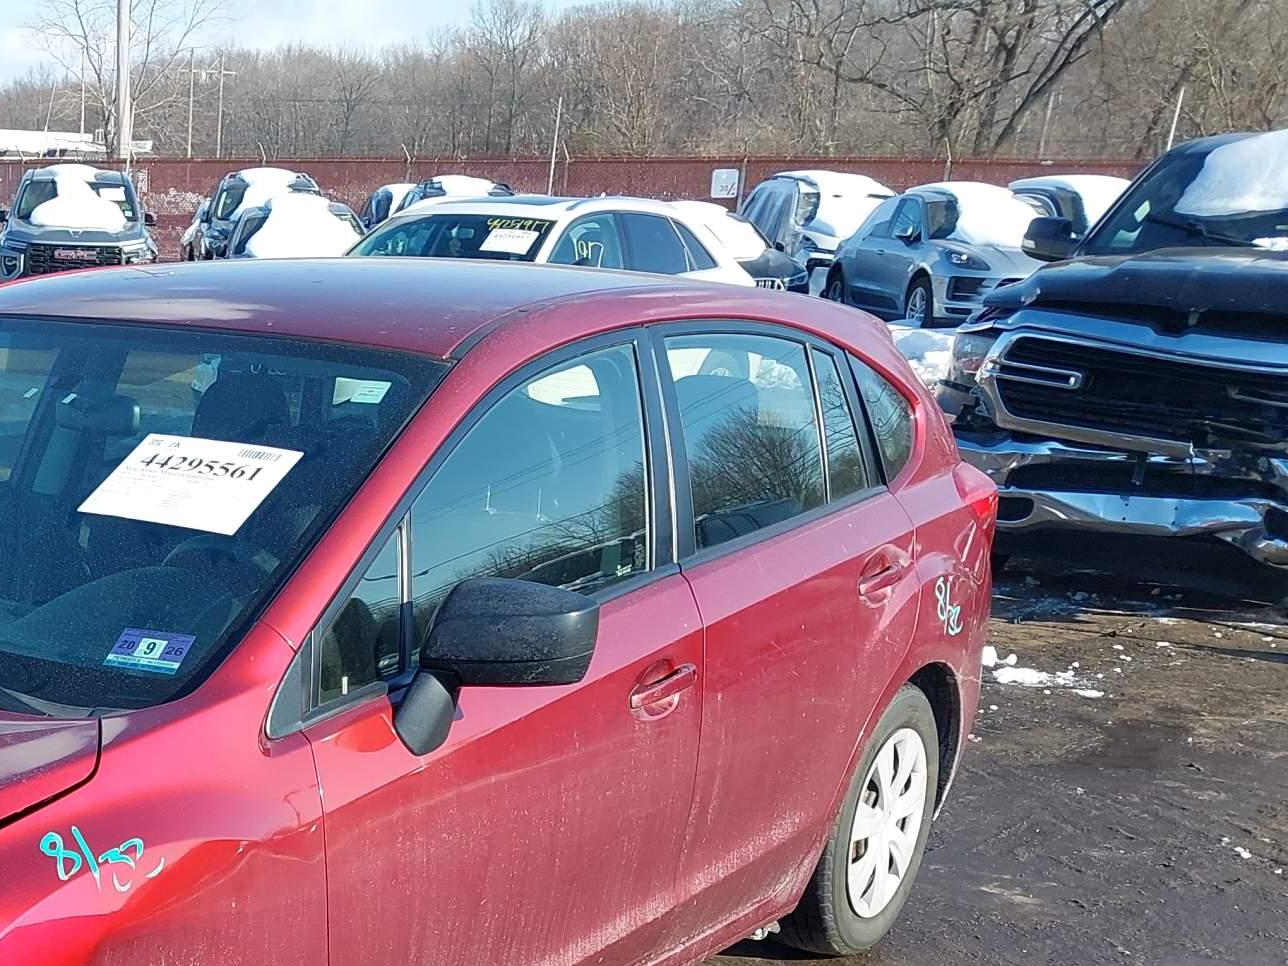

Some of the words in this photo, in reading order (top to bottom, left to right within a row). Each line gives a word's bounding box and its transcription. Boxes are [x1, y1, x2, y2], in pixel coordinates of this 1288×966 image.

[140, 453, 264, 481] 44295561
[118, 640, 136, 650] 20
[143, 641, 157, 656] 9
[165, 646, 184, 657] 26
